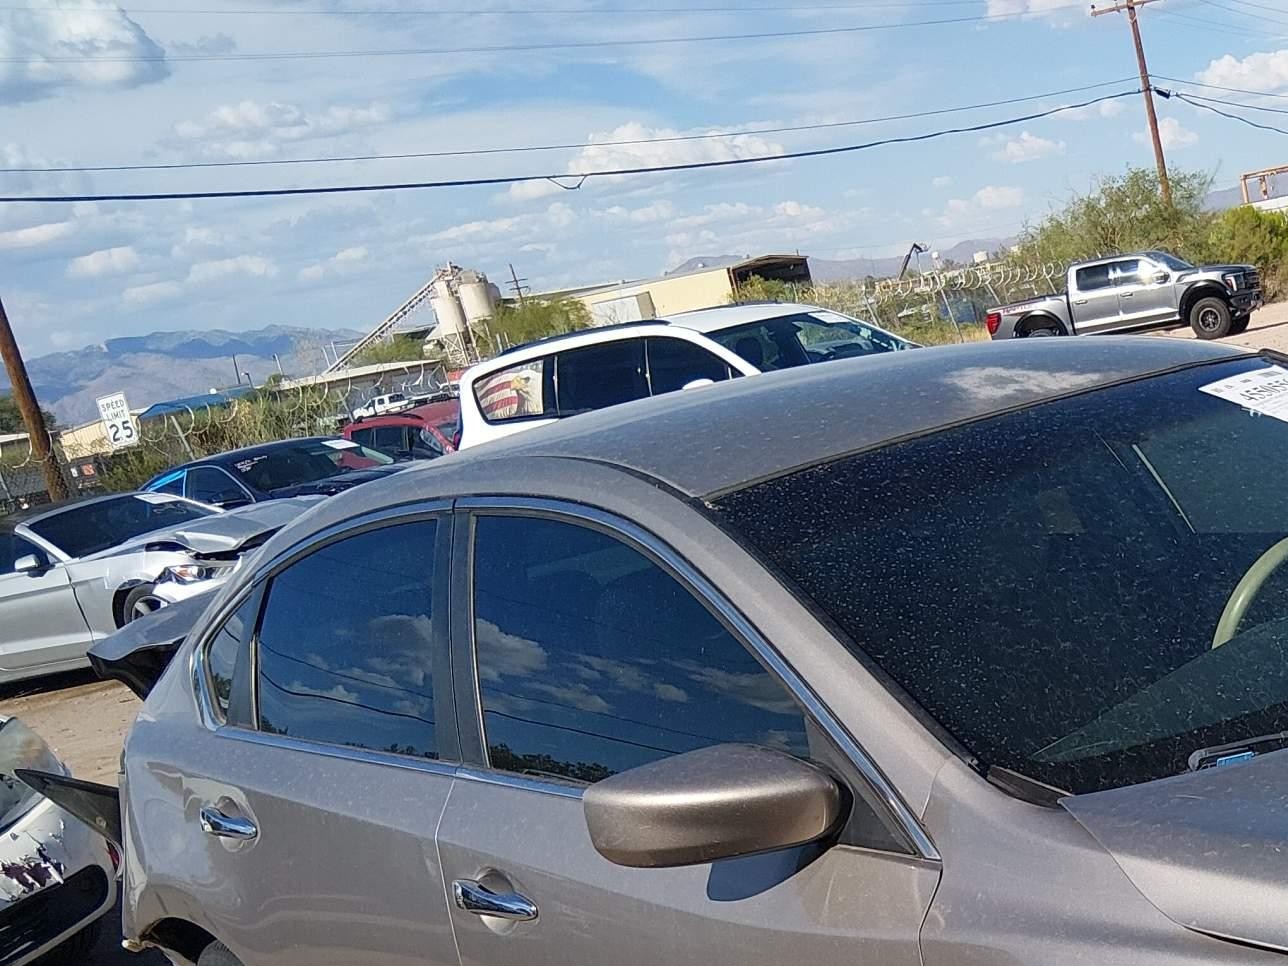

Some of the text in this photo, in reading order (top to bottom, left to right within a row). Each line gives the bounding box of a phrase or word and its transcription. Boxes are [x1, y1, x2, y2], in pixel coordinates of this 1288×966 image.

[101, 400, 125, 412] SPEED
[105, 409, 126, 421] LIMIT
[109, 420, 133, 442] 25
